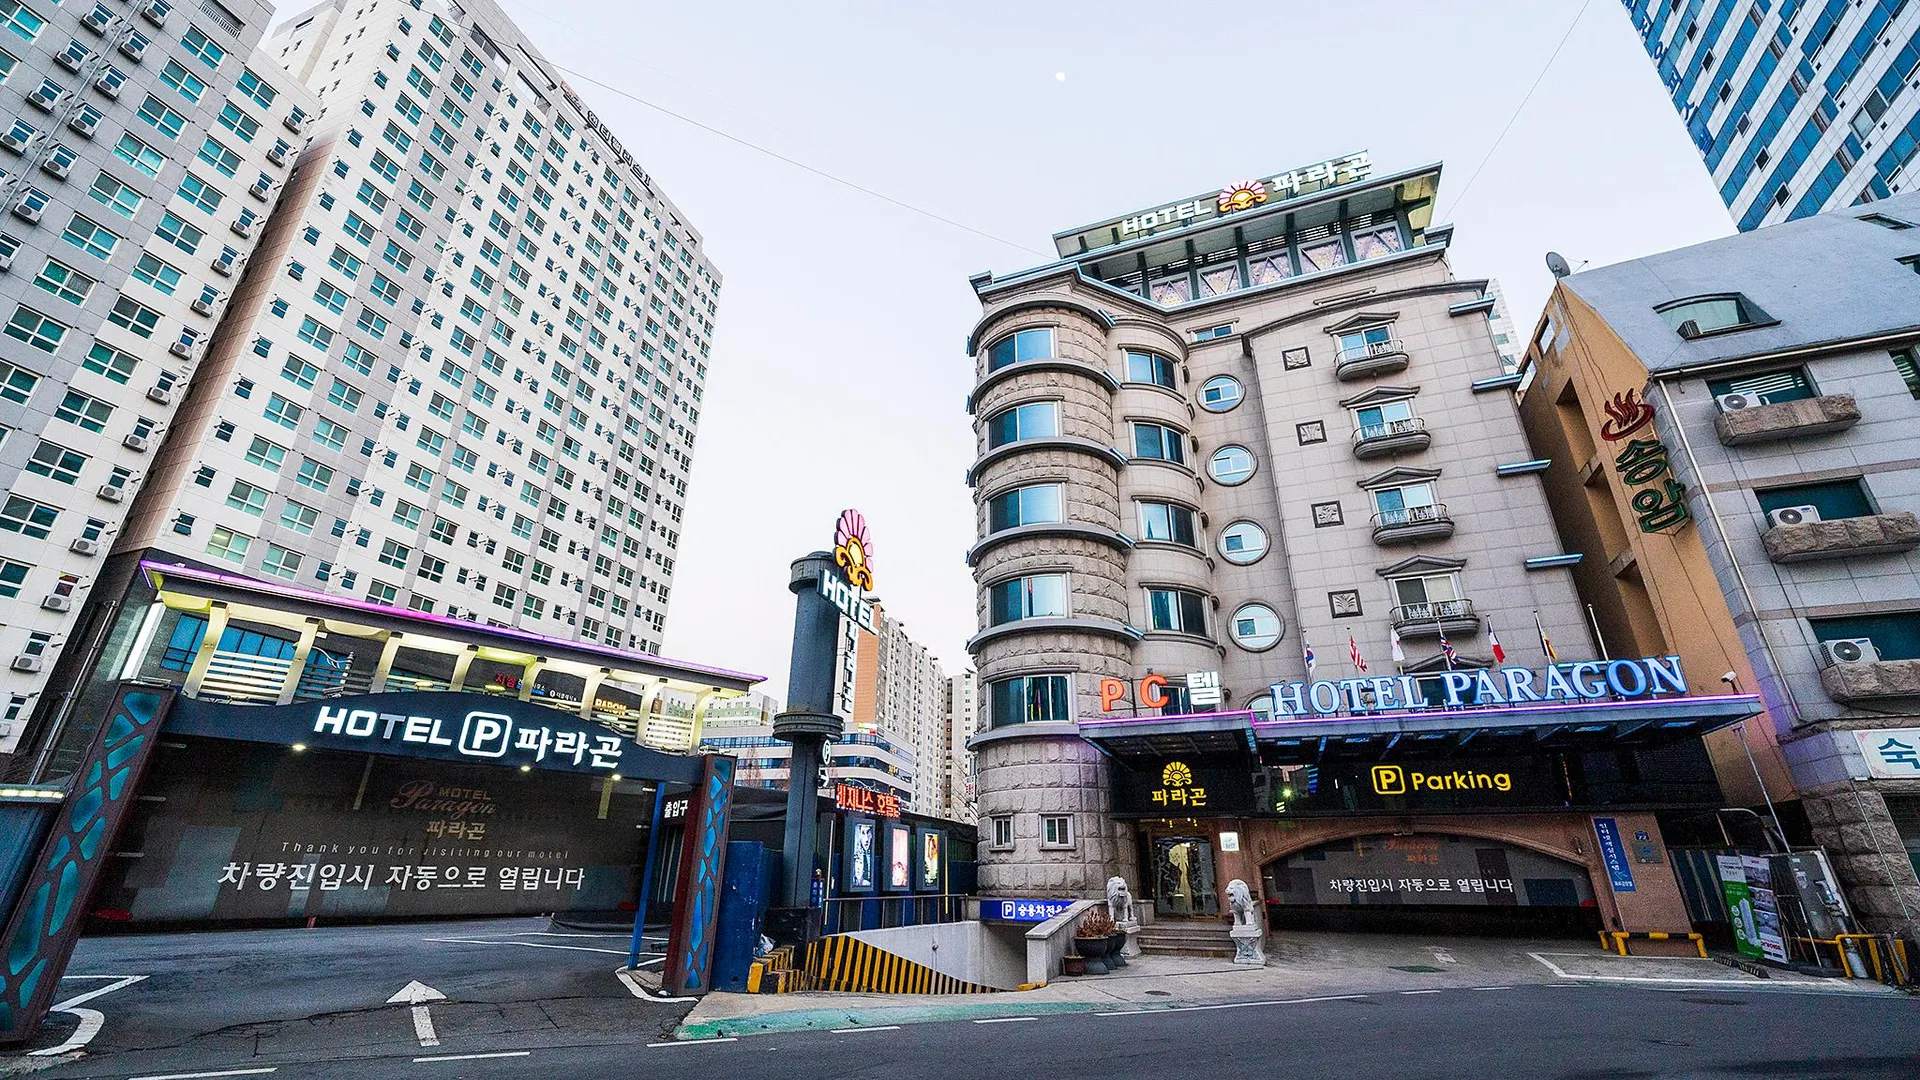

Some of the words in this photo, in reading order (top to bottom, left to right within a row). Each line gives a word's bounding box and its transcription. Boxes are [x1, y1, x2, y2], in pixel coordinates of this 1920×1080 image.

[1121, 199, 1212, 235] HOTEL
[1272, 151, 1373, 194] 파라곤
[1616, 439, 1688, 533] 송암
[822, 569, 880, 636] HOTEL
[1270, 674, 1429, 716] HOTEL
[1440, 656, 1688, 707] PARAGON
[314, 706, 452, 746] HOTEL
[514, 727, 623, 769] 파라곤
[1878, 737, 1920, 770] 숙
[439, 787, 492, 800] MOTEL
[1412, 770, 1512, 793] Parking
[390, 779, 497, 820] Paragon
[664, 799, 688, 819] 출입구
[1152, 788, 1207, 806] 파라곤
[427, 820, 485, 840] 파라곤
[281, 841, 338, 854] Thank
[348, 845, 379, 857] you
[387, 845, 415, 856] for
[497, 849, 521, 858] our
[217, 862, 375, 891] 차량진입시
[385, 864, 487, 891] 자동으로
[498, 866, 585, 891] 열립니다
[1329, 879, 1394, 893] 차량진입시
[1398, 879, 1453, 893] 자동으로
[1457, 879, 1514, 893] 열립니다
[1018, 904, 1070, 918] 승용차전
